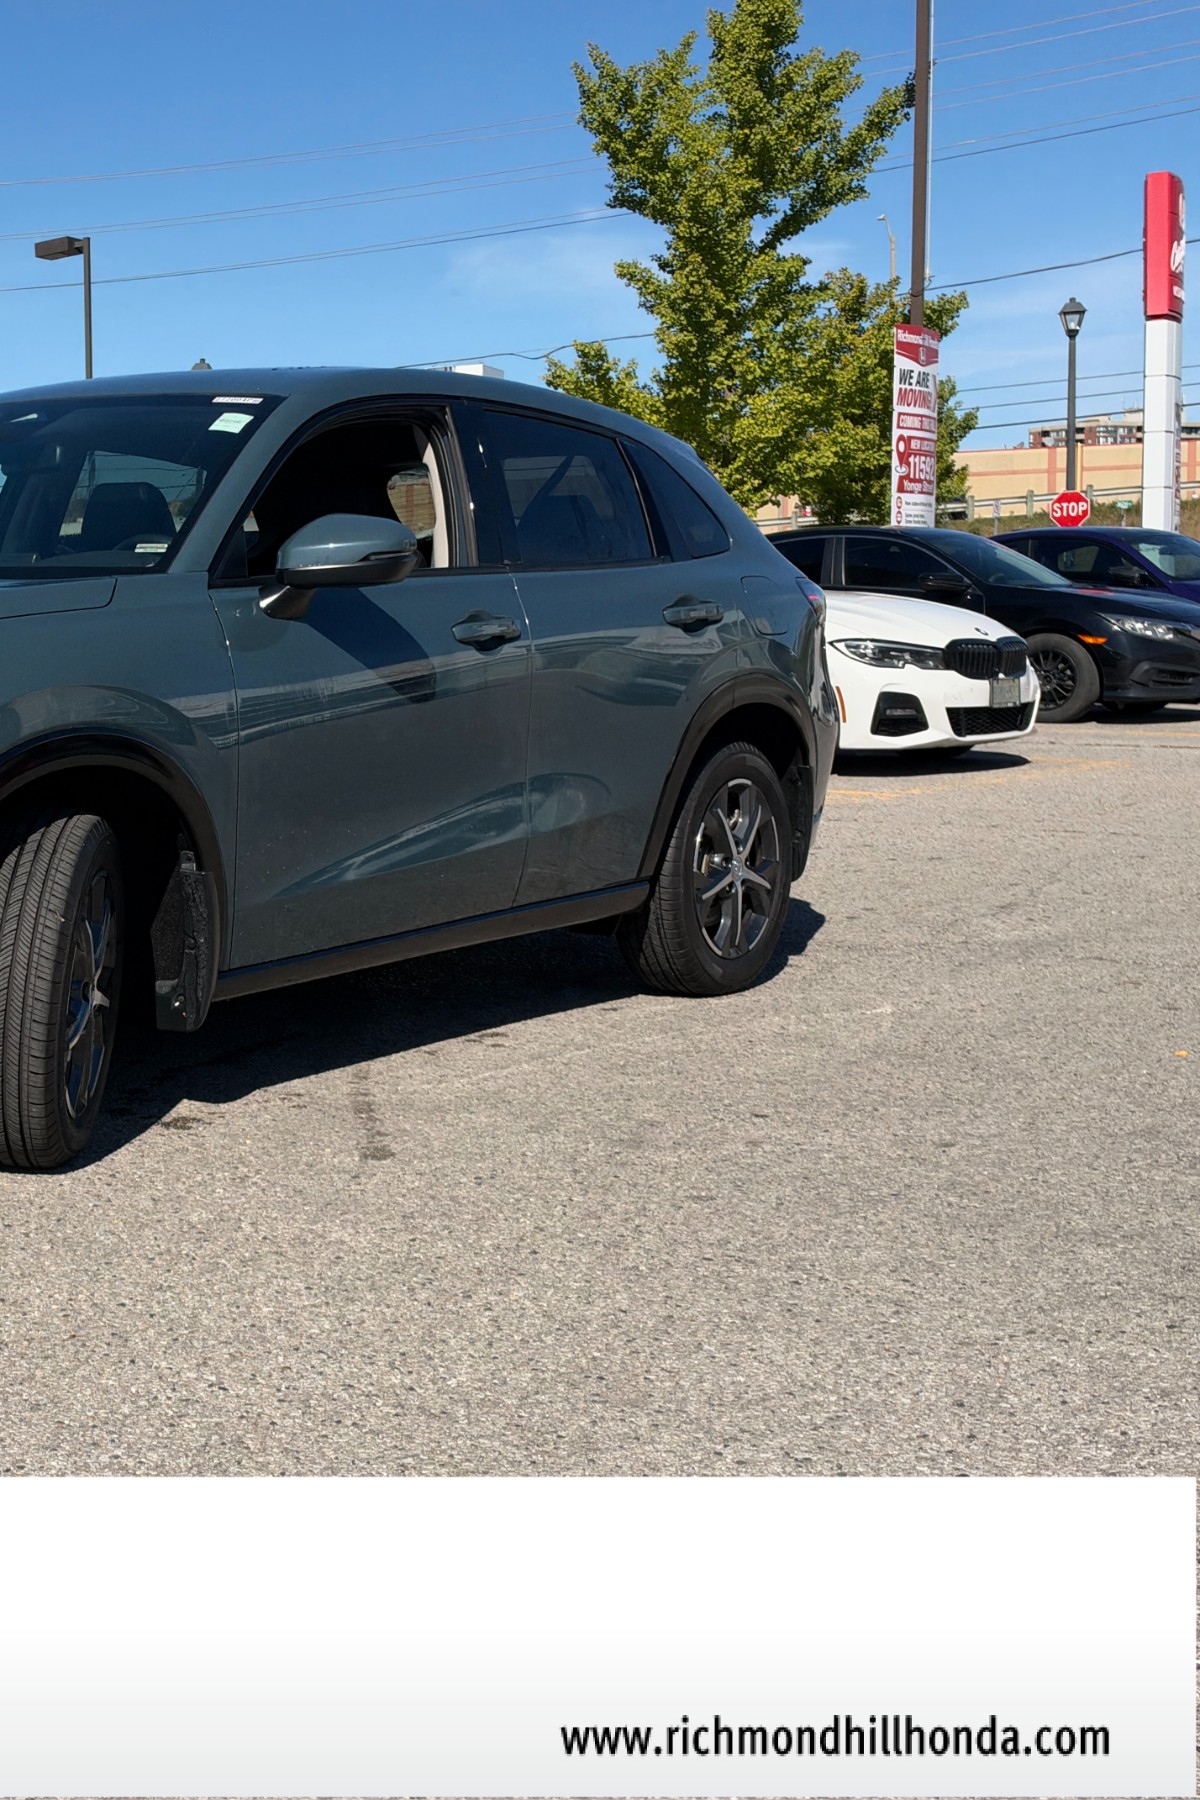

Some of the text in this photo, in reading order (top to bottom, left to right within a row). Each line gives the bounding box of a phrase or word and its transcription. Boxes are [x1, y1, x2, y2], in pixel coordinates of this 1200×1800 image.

[899, 367, 930, 389] WE ARE
[899, 414, 922, 429] COMING
[908, 454, 935, 480] 11592
[903, 479, 922, 494] Yonge
[1052, 502, 1087, 517] STOP
